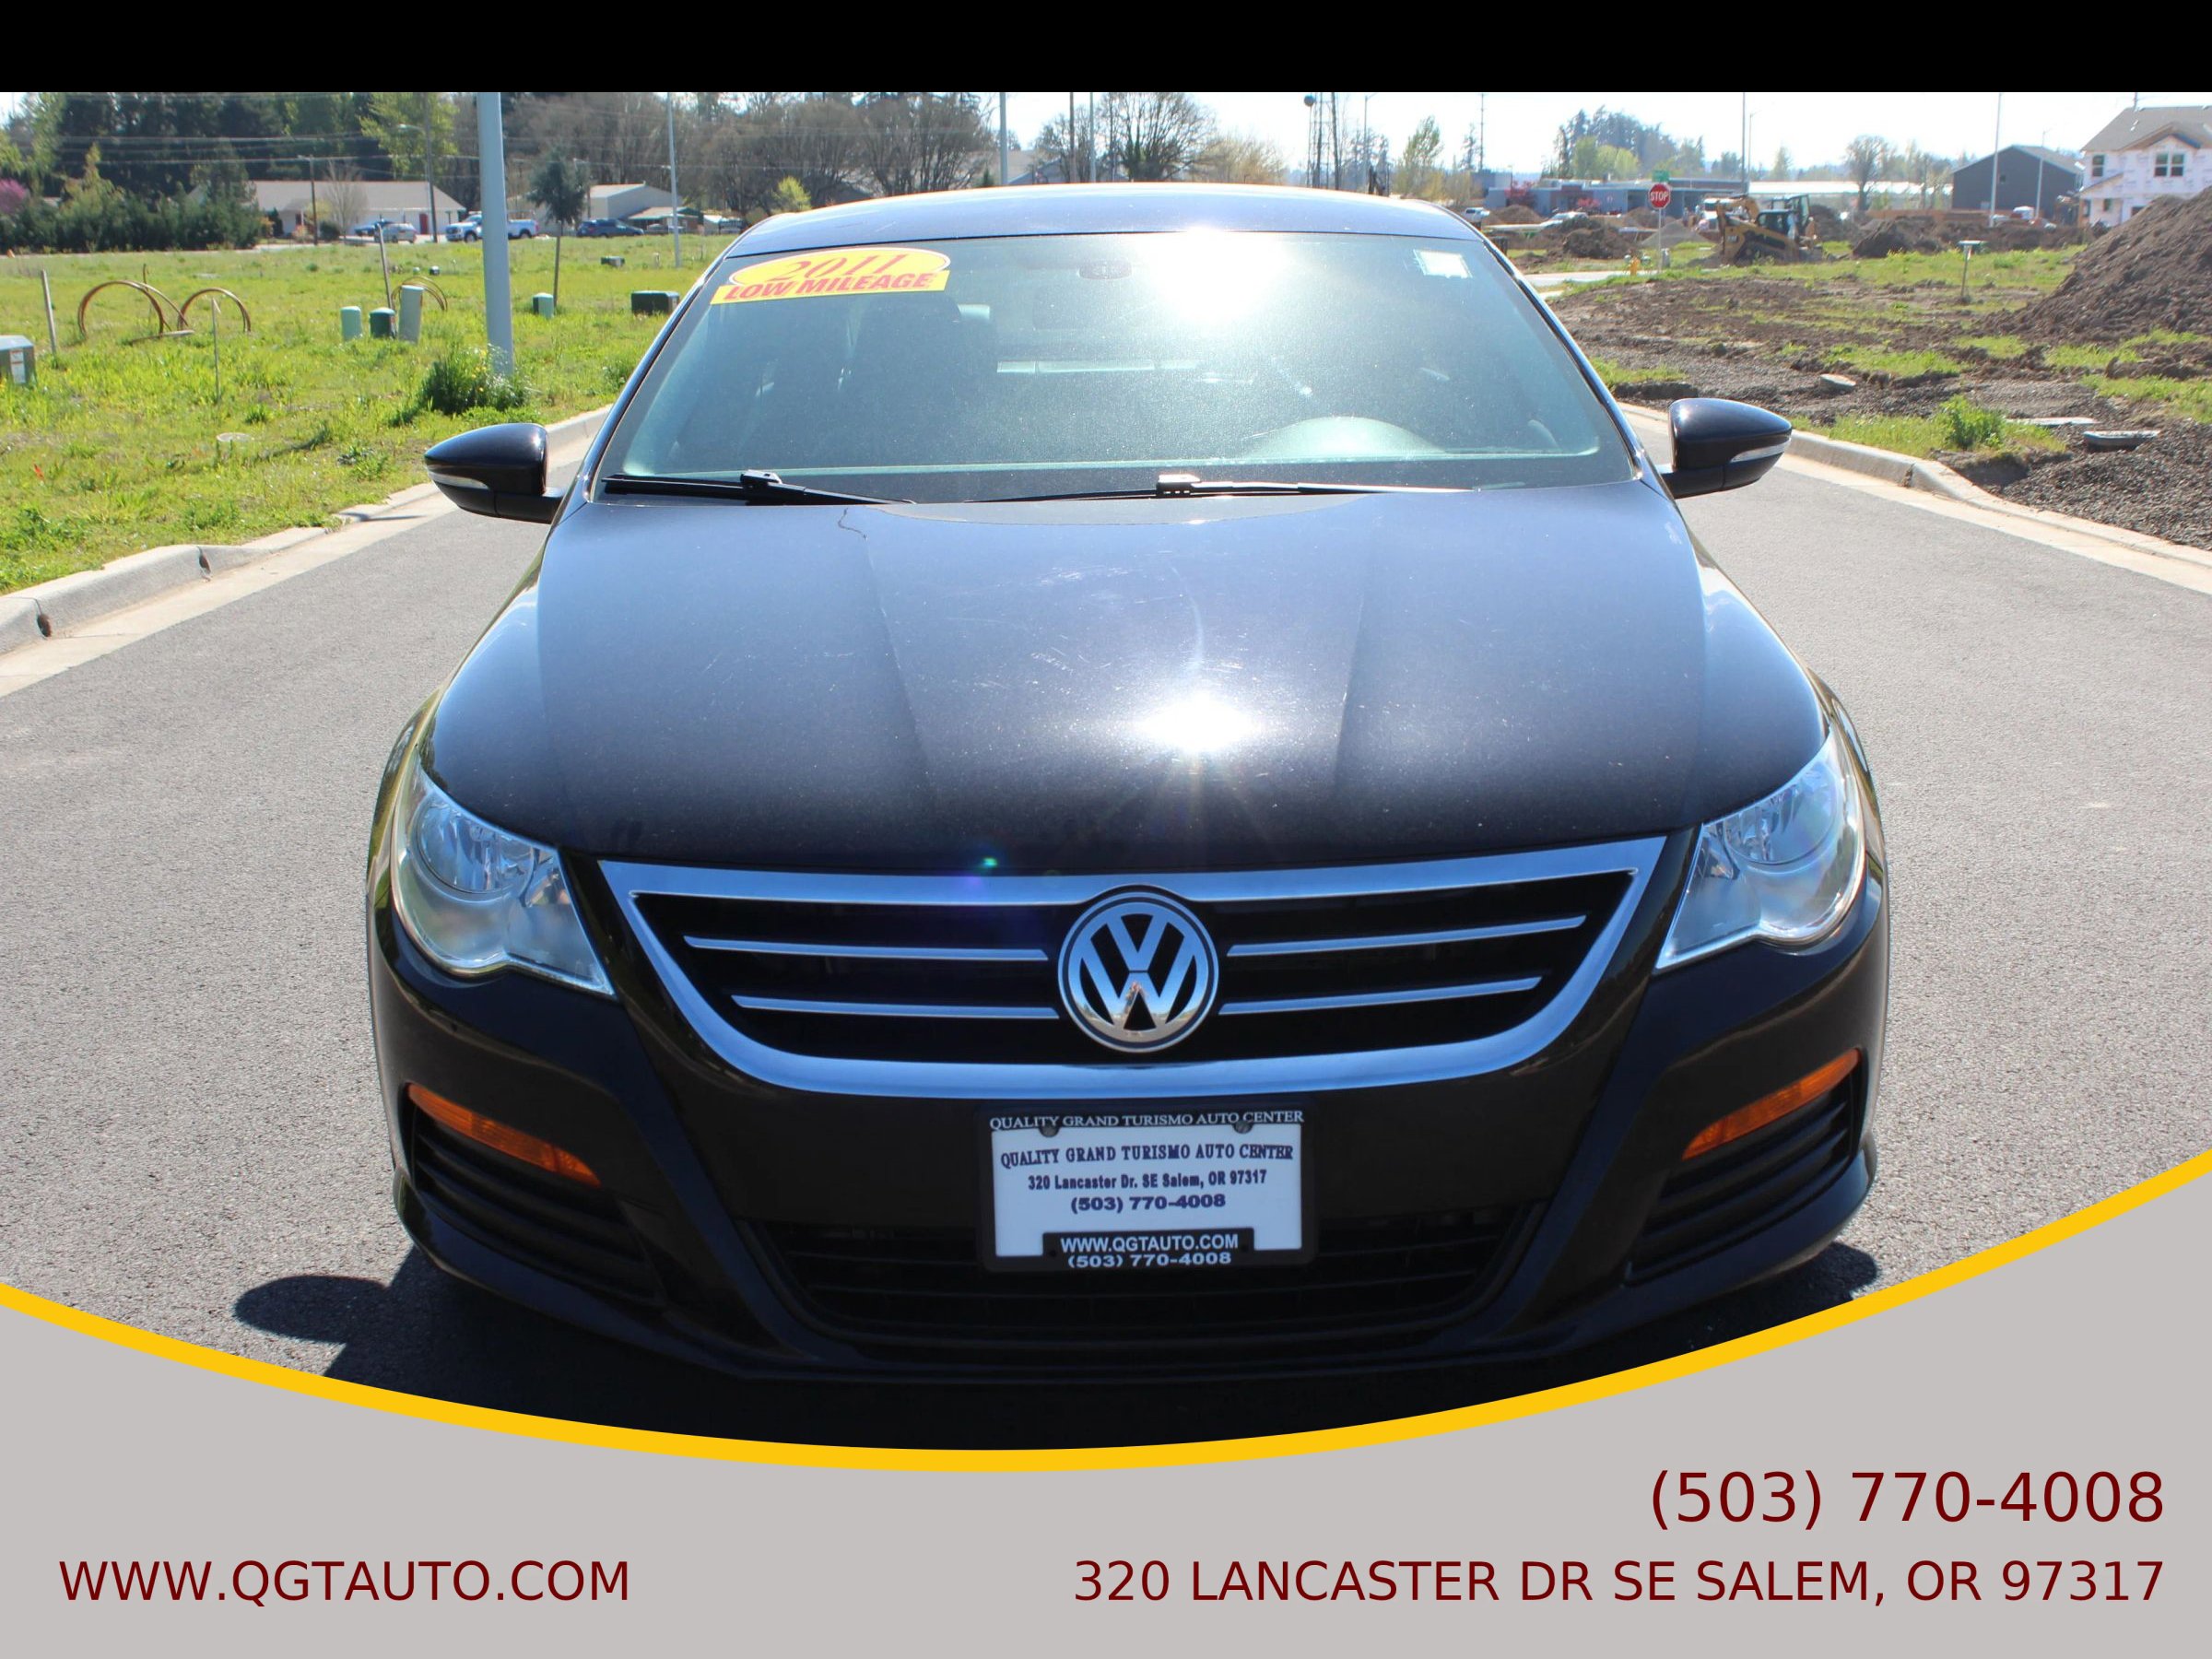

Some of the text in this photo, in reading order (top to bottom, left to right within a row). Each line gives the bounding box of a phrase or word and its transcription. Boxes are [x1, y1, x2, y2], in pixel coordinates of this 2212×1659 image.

[1650, 192, 1668, 201] STOP
[767, 253, 909, 282] 2011
[724, 273, 935, 300] LOW MILEAGE
[990, 1111, 1304, 1131] QUALITY GRAND TURISMO AUTO CENTER
[1001, 1144, 1294, 1169] QUALITY GRAND TURISMO AUTO CENTER
[1029, 1170, 1266, 1190] 320 Lancaster Dr. SE Salem, OR 97317
[1071, 1194, 1226, 1213] (503) 770-4008
[1061, 1234, 1239, 1253] WWW.QGTAUTO.COM
[1068, 1252, 1231, 1268] (503) 770-4008
